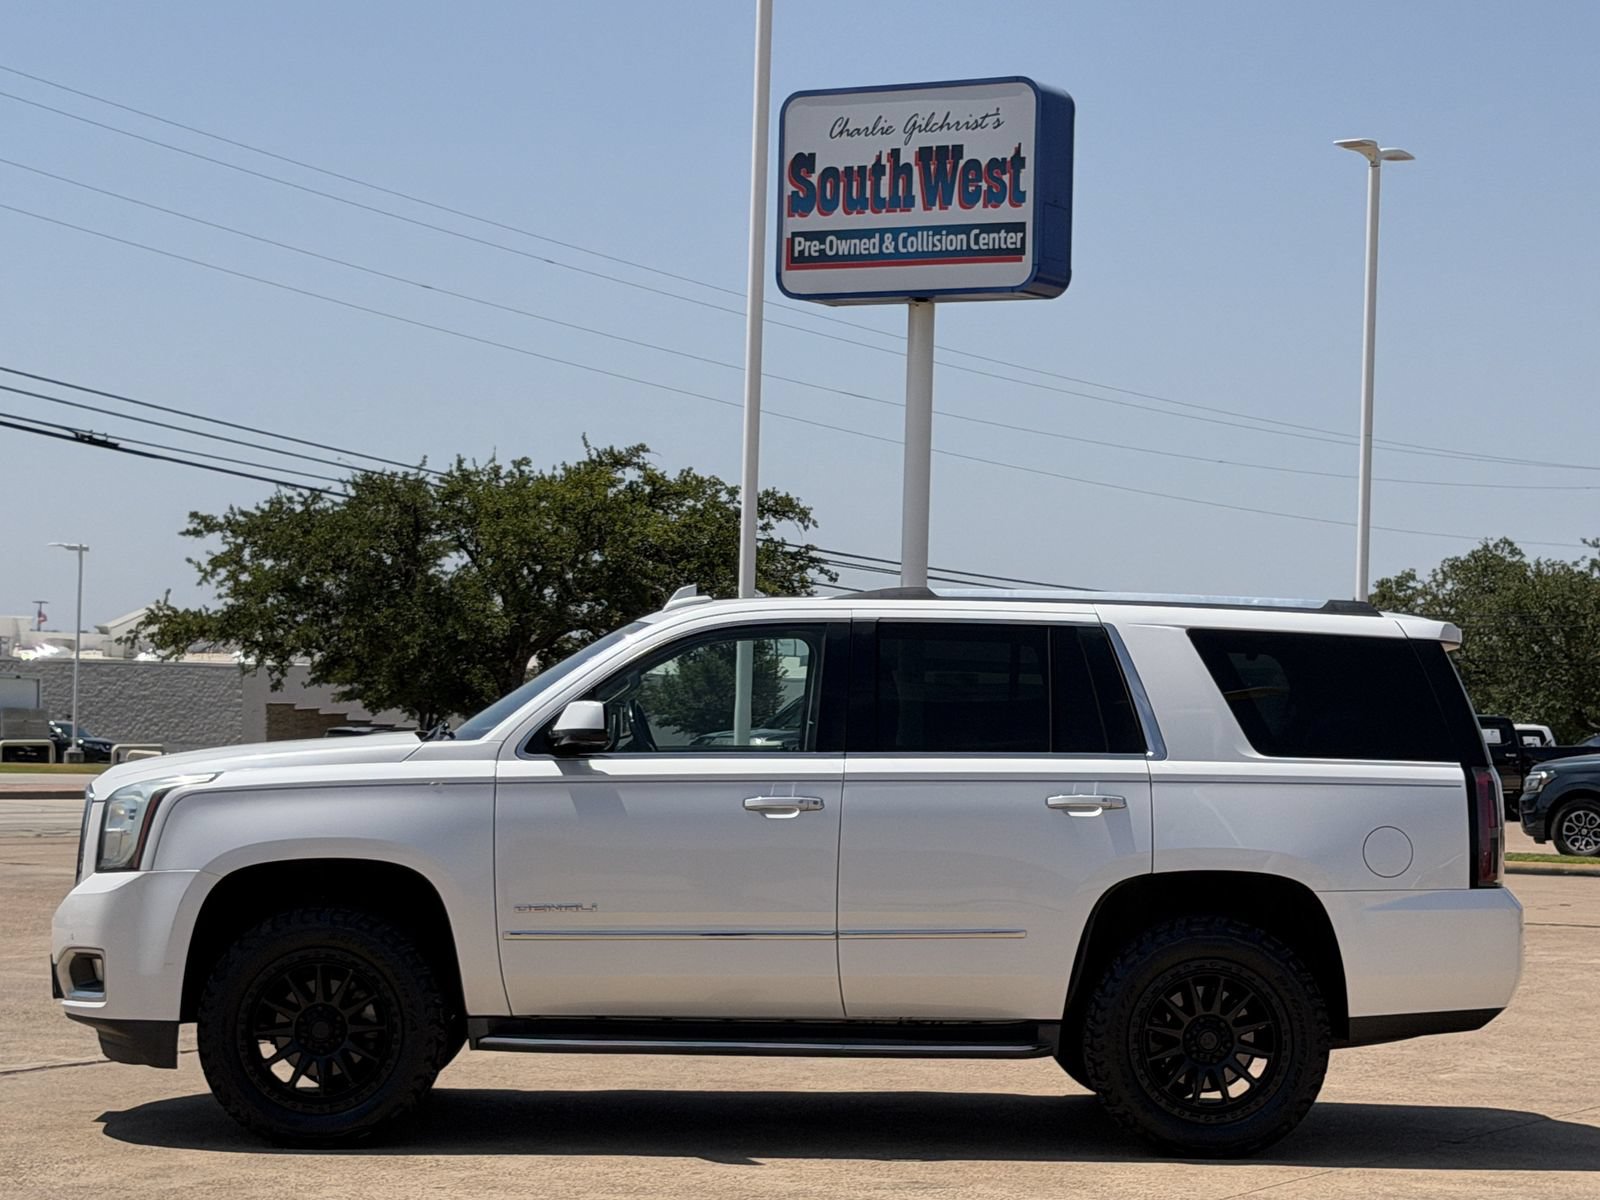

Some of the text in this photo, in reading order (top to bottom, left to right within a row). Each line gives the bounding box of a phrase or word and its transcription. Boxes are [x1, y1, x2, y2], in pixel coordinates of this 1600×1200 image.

[829, 108, 1004, 145] Charlie Gilchrist's
[793, 228, 1024, 257] Pre-Owned & Collision Center
